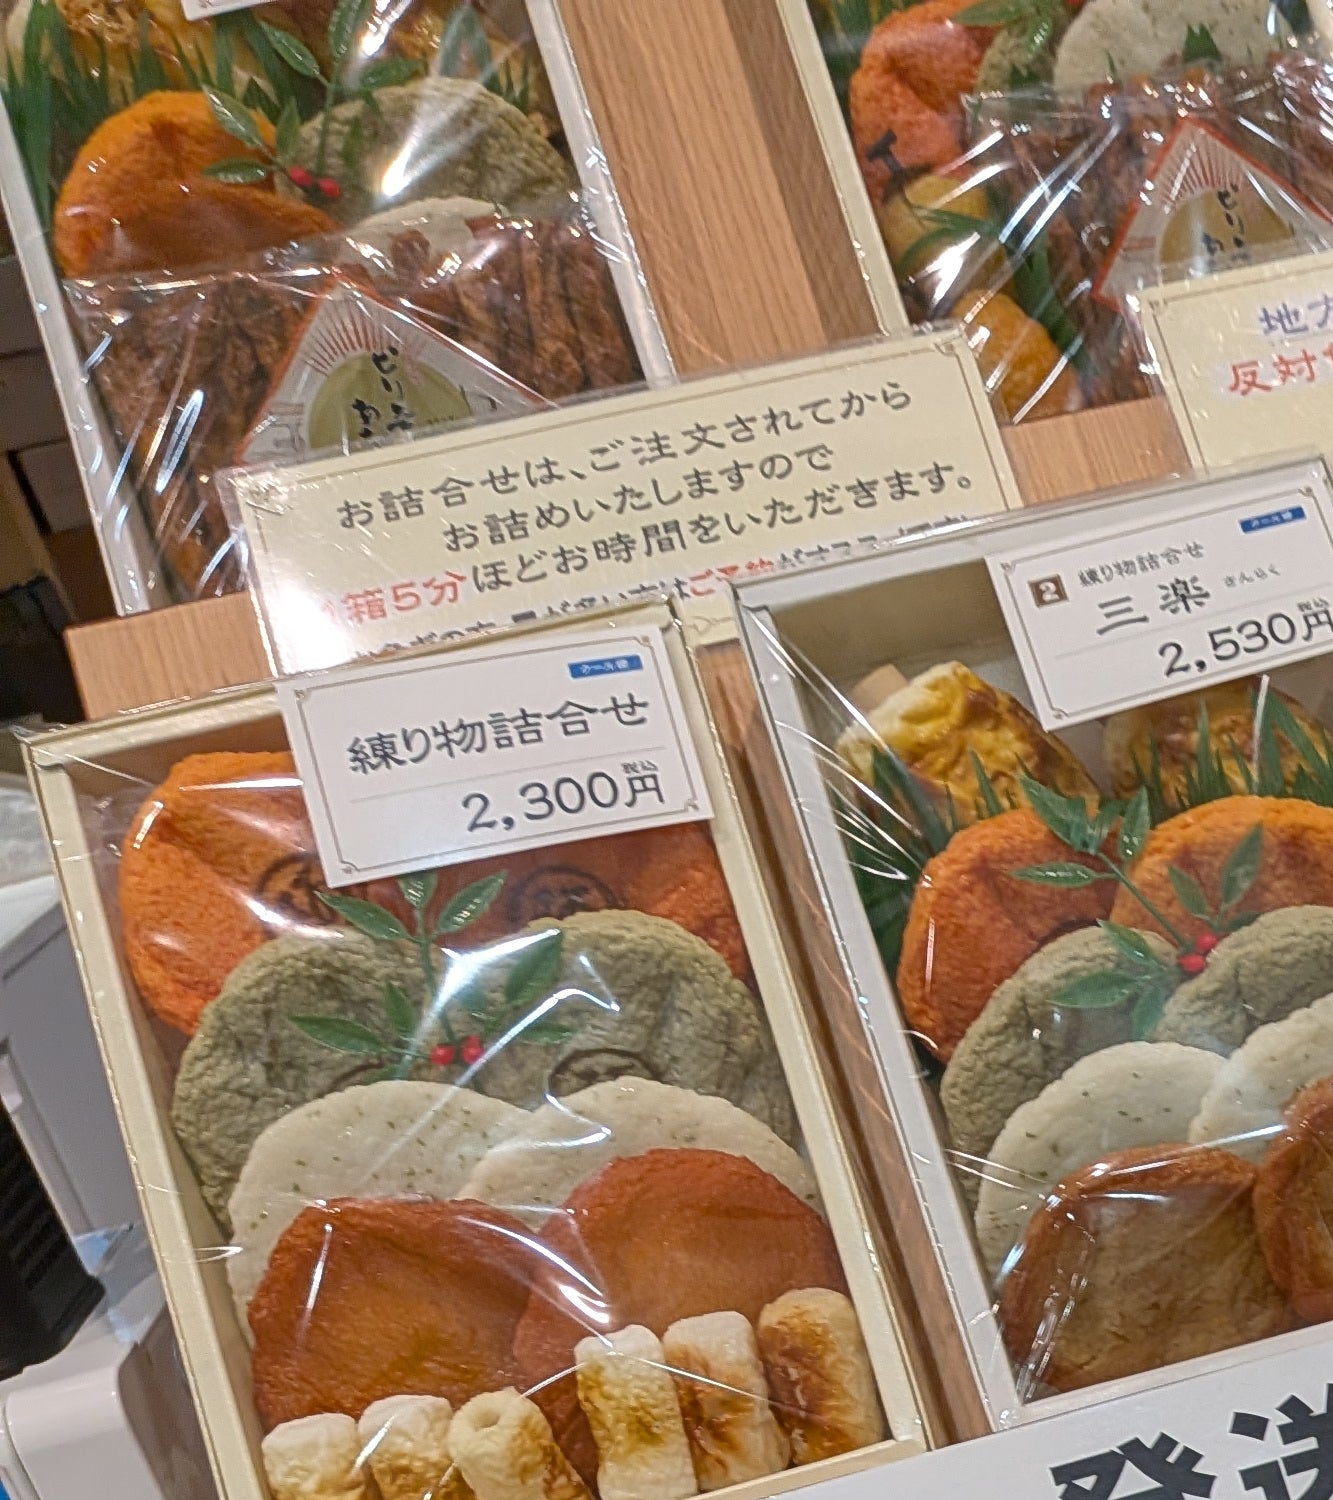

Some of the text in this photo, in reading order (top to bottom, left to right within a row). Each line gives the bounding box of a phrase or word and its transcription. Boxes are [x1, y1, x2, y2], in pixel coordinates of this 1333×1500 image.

[339, 381, 911, 531] お詰合せは、ご注文されてから
[444, 442, 834, 552] お詰めいたしますので
[1039, 580, 1063, 603] 2
[1096, 574, 1210, 636] 三楽
[346, 691, 651, 776] 練り物詰合せ
[461, 770, 666, 833] 2,300円
